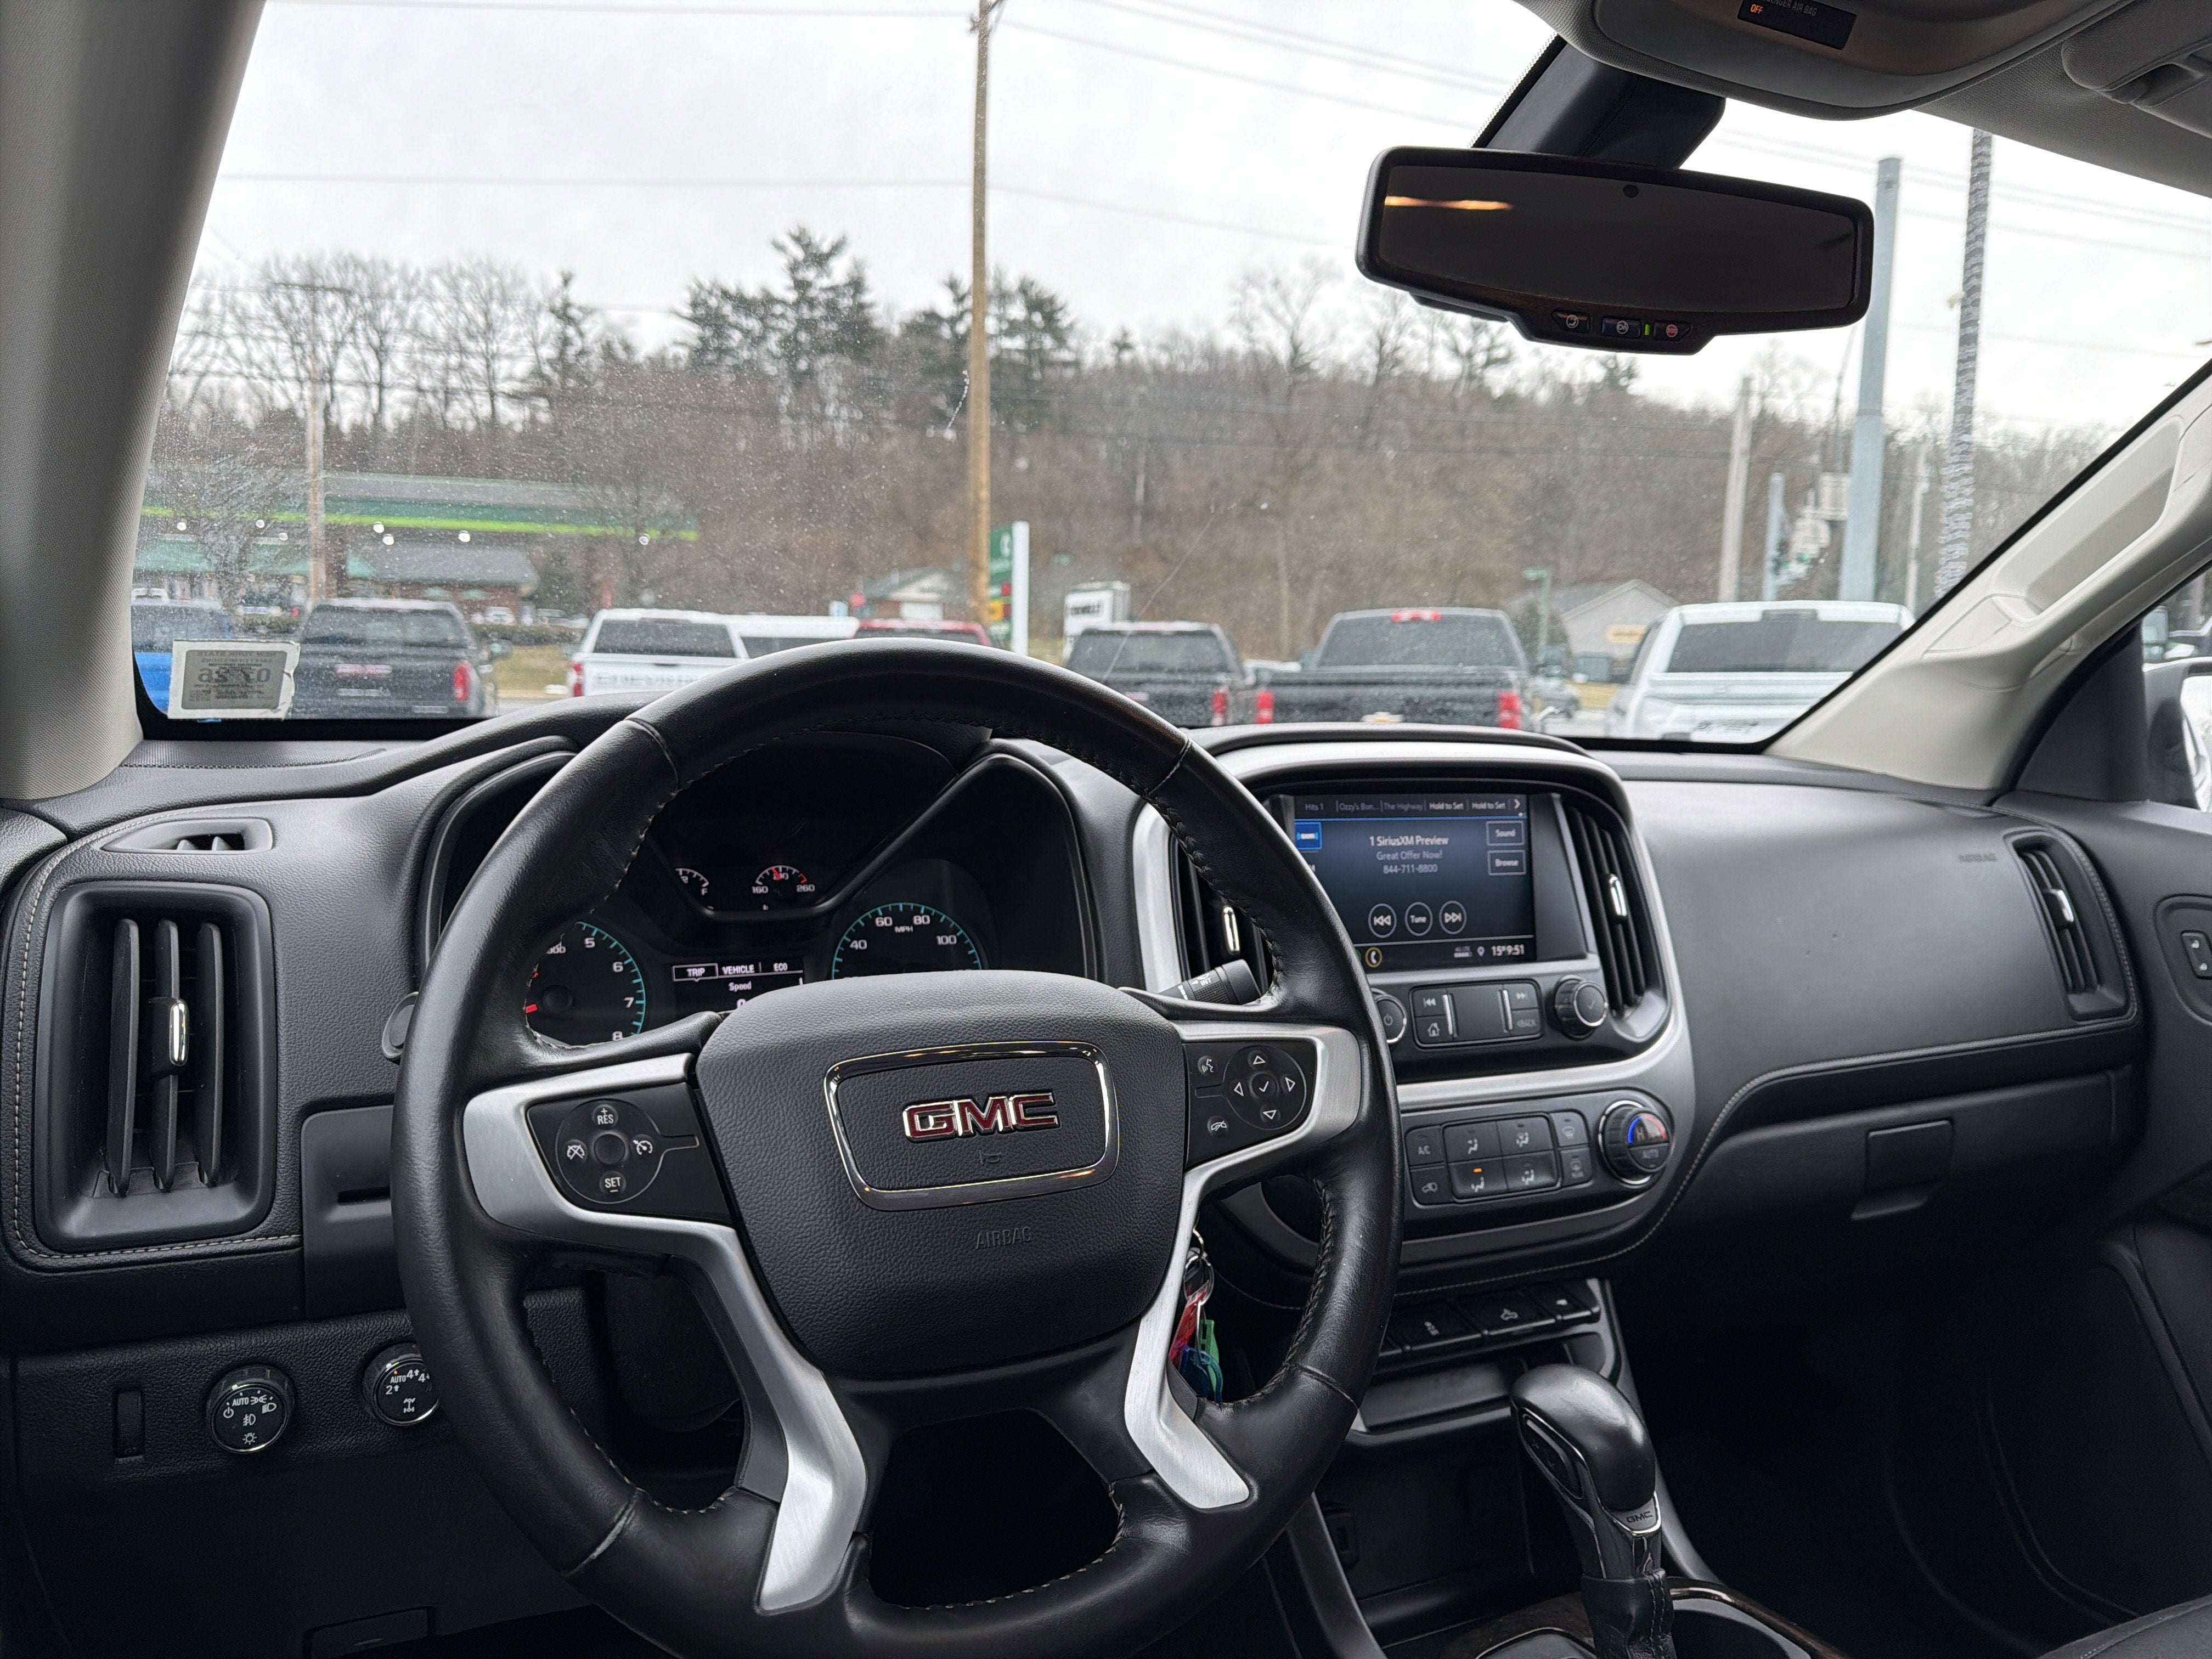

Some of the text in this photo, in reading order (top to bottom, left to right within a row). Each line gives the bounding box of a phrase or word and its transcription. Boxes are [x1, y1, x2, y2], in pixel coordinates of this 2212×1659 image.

[1750, 4, 1764, 14] OFF
[1791, 2, 1804, 12] AIR
[1803, 5, 1818, 16] BAG
[1305, 803, 1319, 811] Hits
[1339, 803, 1360, 812] Ozzy's
[1396, 803, 1423, 812] Highway
[1429, 802, 1444, 810] Hold
[1453, 802, 1464, 810] Set
[1472, 802, 1487, 810] Hold
[1494, 801, 1506, 810] Set
[1495, 829, 1516, 838] Sound
[1369, 834, 1449, 847] 1 SiriusXM Preview
[1376, 849, 1443, 861] Great Offer Now!
[1495, 859, 1519, 867] Browse
[1383, 864, 1438, 874] 844-711-8800
[752, 885, 769, 894] 160
[796, 884, 815, 893] 260
[875, 916, 893, 927] 60
[913, 915, 930, 926] 80
[1409, 915, 1427, 923] Tune
[584, 937, 595, 949] 5
[850, 939, 867, 950] 40
[936, 935, 957, 945] 100
[612, 961, 624, 973] 6
[687, 967, 706, 977] TRIP
[721, 964, 755, 975] VEHICLE
[772, 962, 788, 972] ECO
[728, 981, 752, 992] Speed
[1200, 977, 1212, 986] INT
[623, 996, 635, 1008] 7
[612, 1031, 623, 1041] 8
[597, 1114, 614, 1125] RES
[902, 1091, 1061, 1142] GMC
[605, 1177, 622, 1188] SET
[975, 1227, 1032, 1250] AIRBAG
[390, 1375, 407, 1384] AUTO
[232, 1397, 250, 1406] AUTO
[1626, 1511, 1653, 1523] GMC
